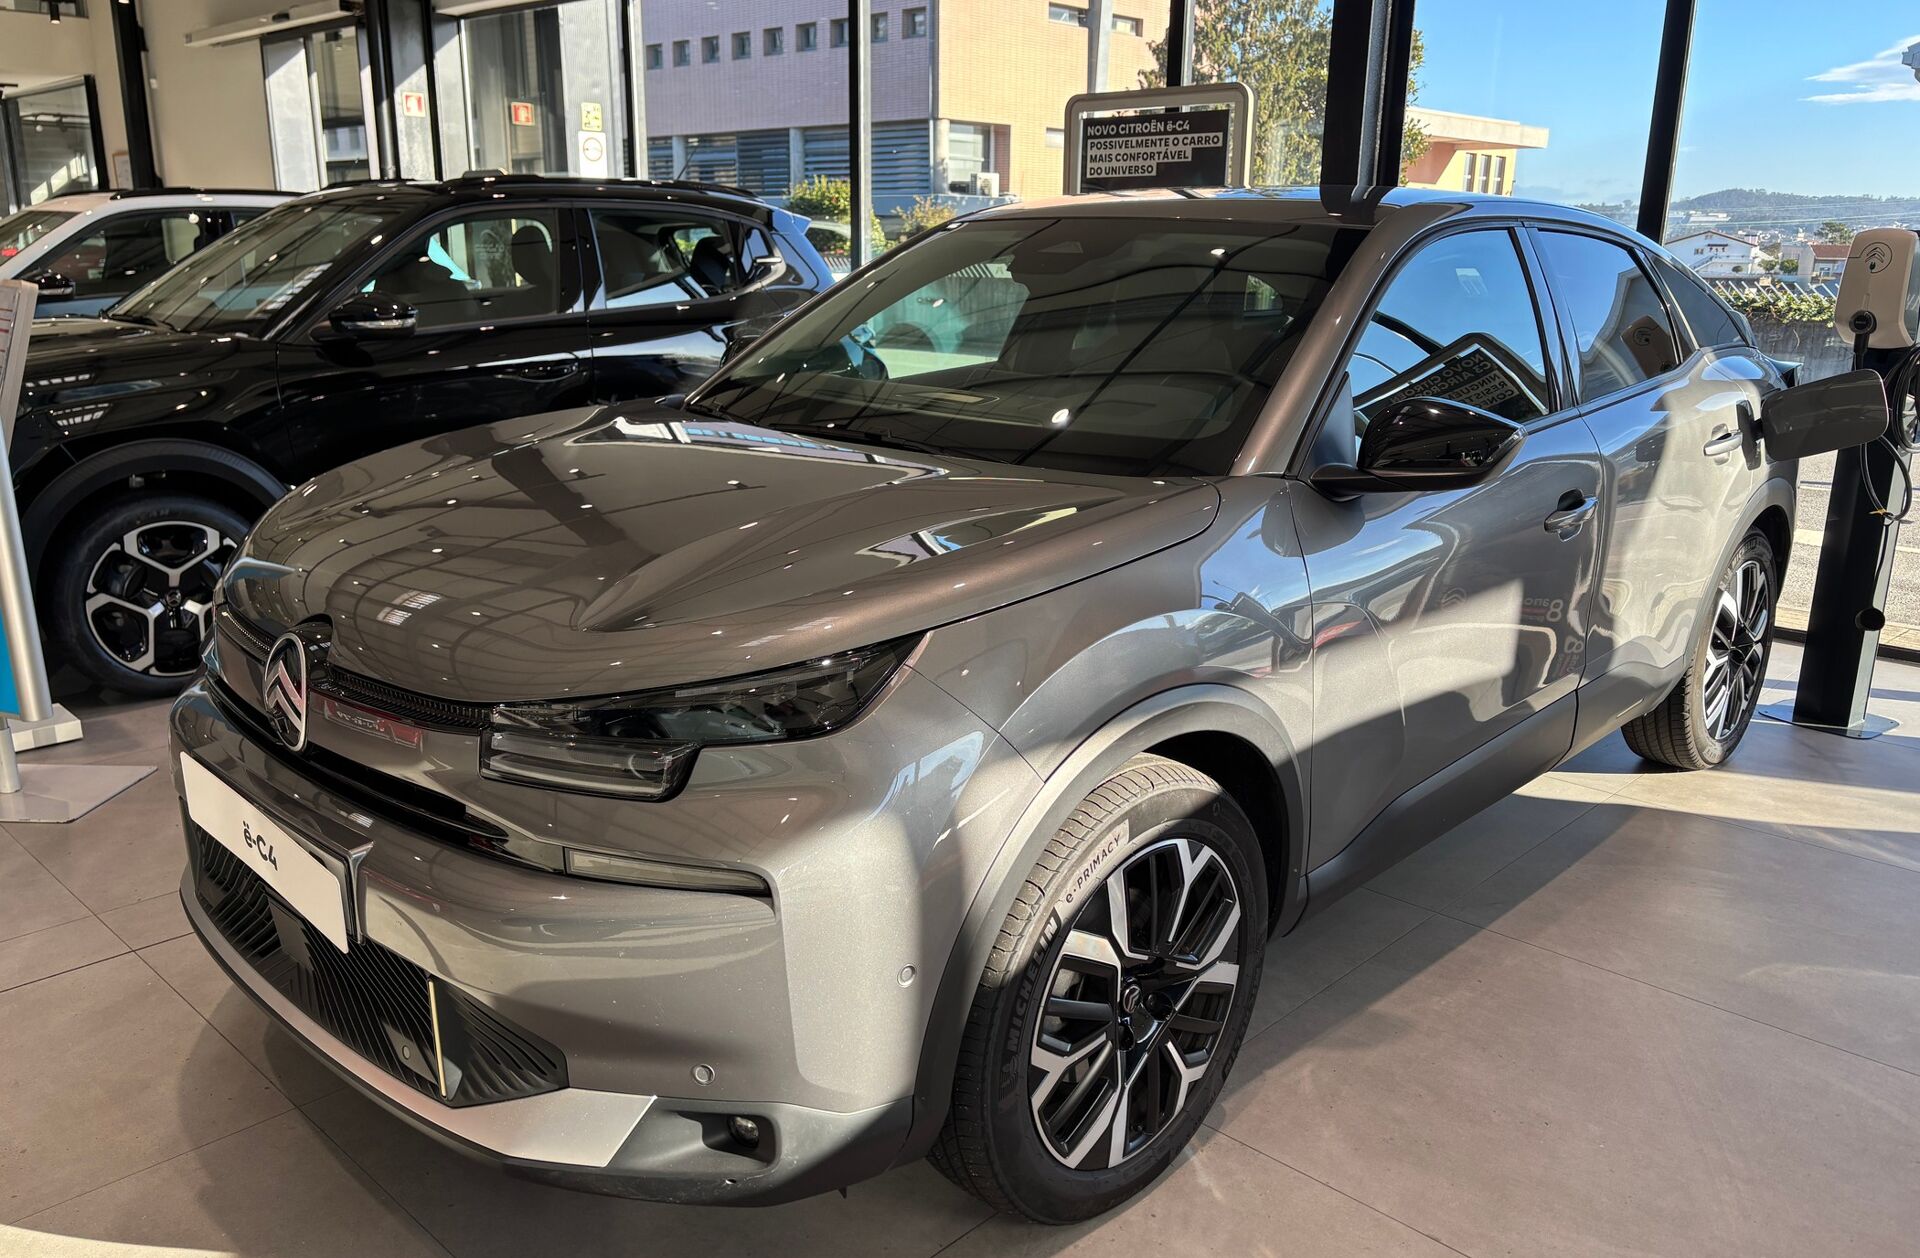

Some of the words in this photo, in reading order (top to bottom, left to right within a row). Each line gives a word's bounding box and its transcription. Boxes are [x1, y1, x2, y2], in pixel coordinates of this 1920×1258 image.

[1087, 125, 1117, 136] NOVO
[1118, 120, 1165, 134] CITROËN
[1089, 138, 1170, 150] POSSIVELMENTE
[1172, 136, 1180, 147] O
[1181, 134, 1220, 146] CARRO
[1089, 153, 1113, 163] MAIS
[1114, 148, 1189, 162] CONFORTÁVEL
[1089, 166, 1103, 176] DO
[1104, 164, 1154, 175] UNIVERSO
[243, 820, 278, 871] ë-C4
[1007, 914, 1058, 1051] MICHELIN
